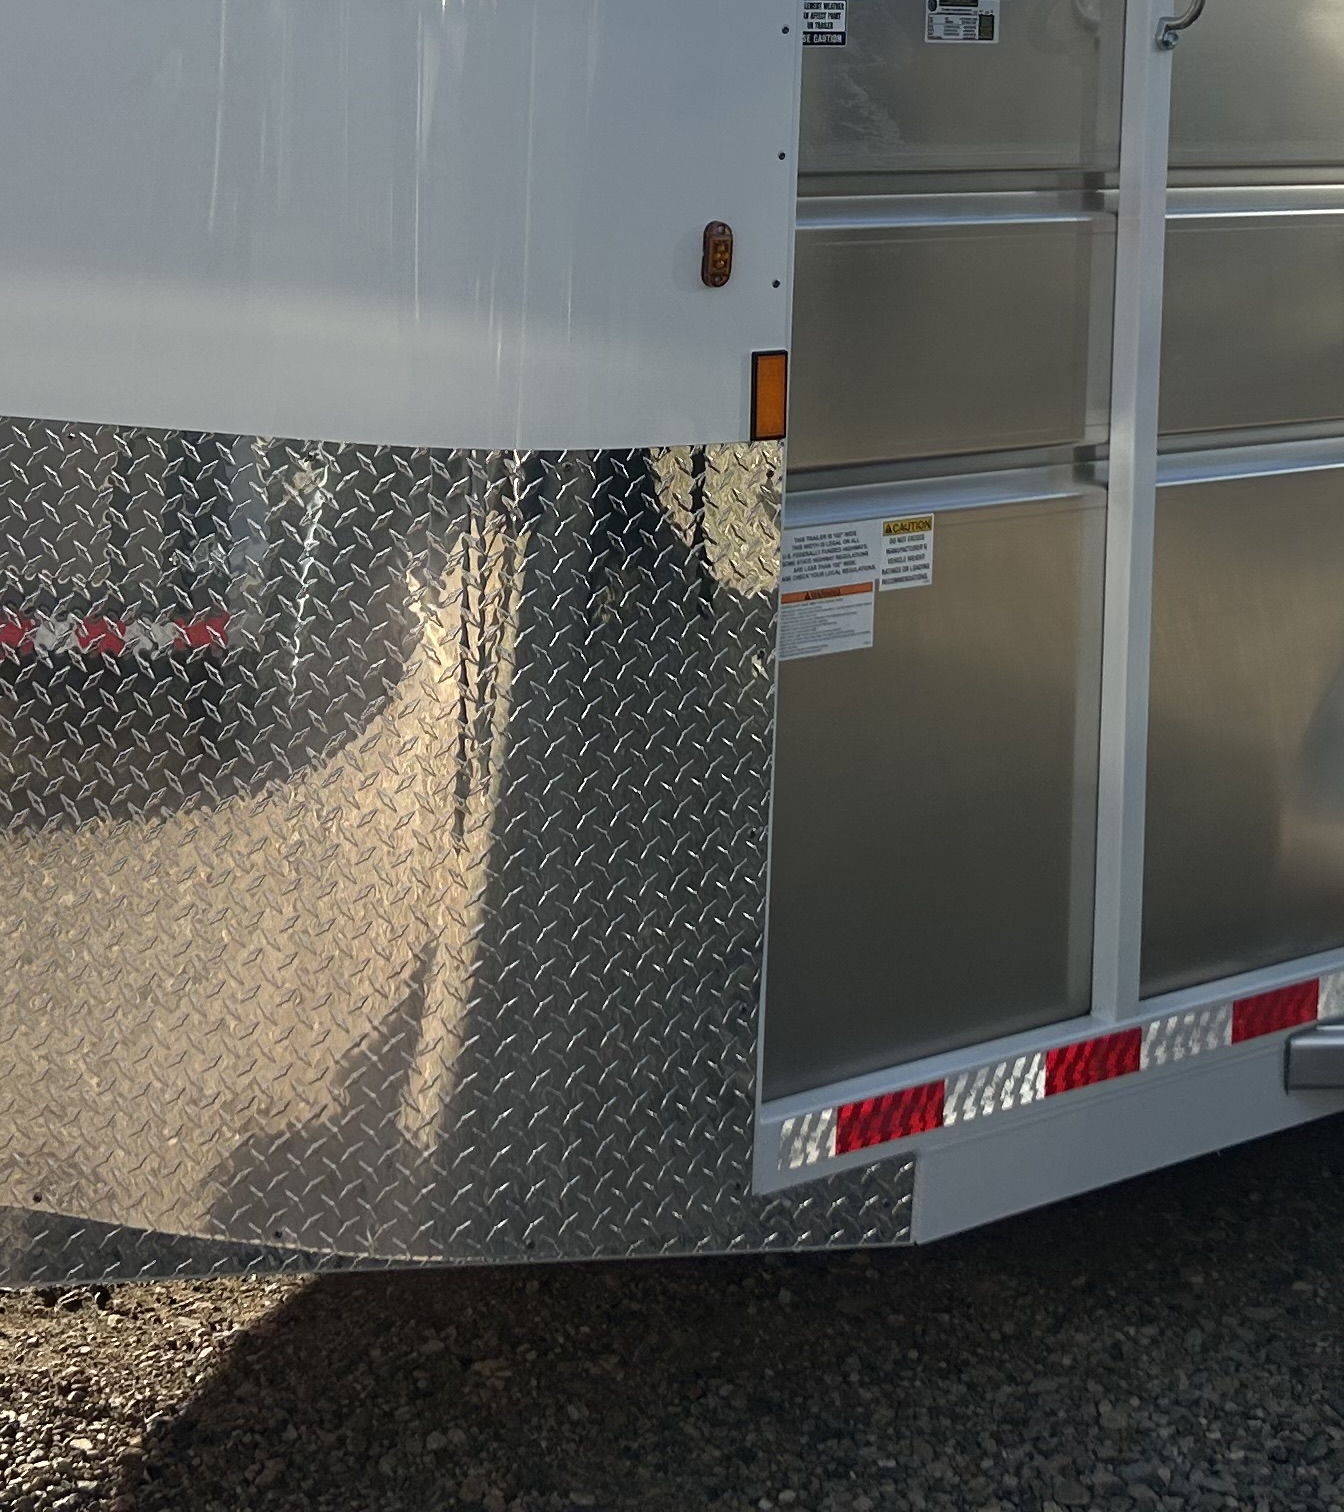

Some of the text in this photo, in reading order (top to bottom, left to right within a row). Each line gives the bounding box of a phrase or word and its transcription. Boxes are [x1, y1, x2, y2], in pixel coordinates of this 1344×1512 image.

[823, 2, 844, 10] WEATHER
[814, 34, 842, 43] CAUTION
[892, 520, 931, 533] CAUTION
[793, 573, 809, 581] CHECK
